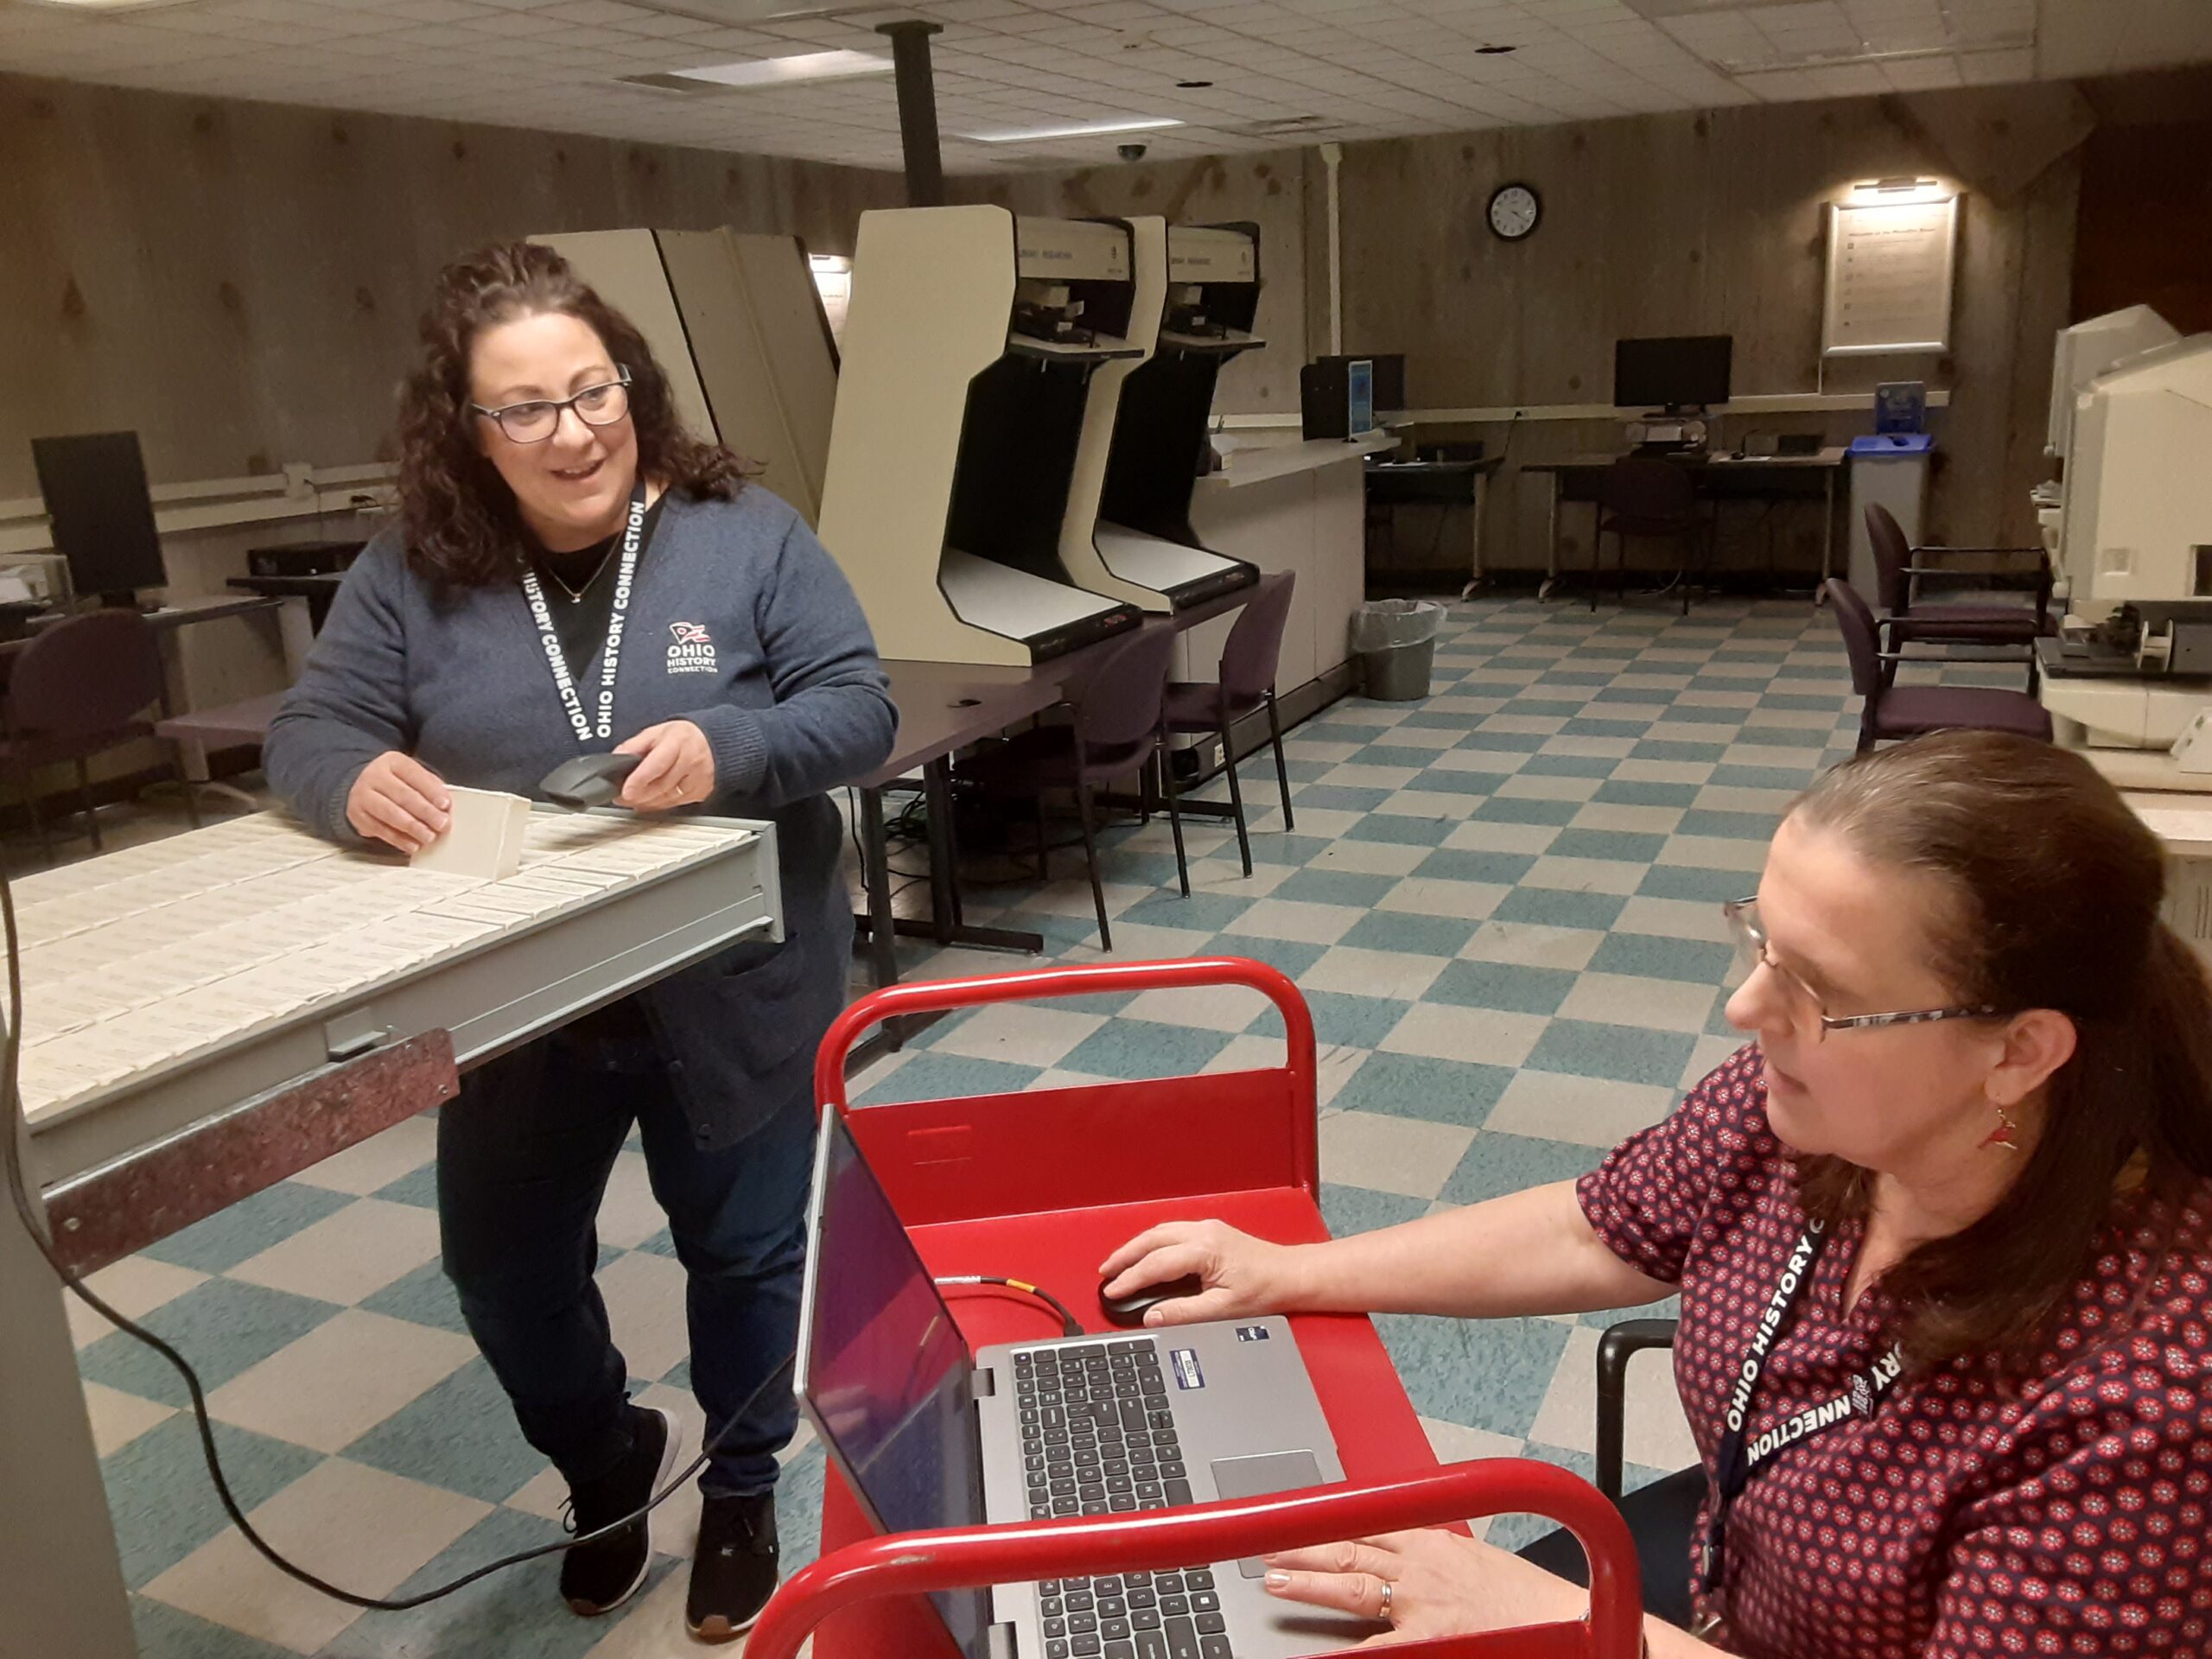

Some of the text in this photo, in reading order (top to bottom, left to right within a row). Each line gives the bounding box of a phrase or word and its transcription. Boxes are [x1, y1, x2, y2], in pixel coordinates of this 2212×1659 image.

[597, 501, 645, 738] OHIO HISTORY CONNECTION
[666, 657, 716, 667] HISTORY
[667, 644, 715, 658] OHIO
[541, 634, 594, 741] CONNECTION
[1727, 1235, 1814, 1433] OHIO HISTORY
[1746, 1395, 1852, 1467] NNECTION
